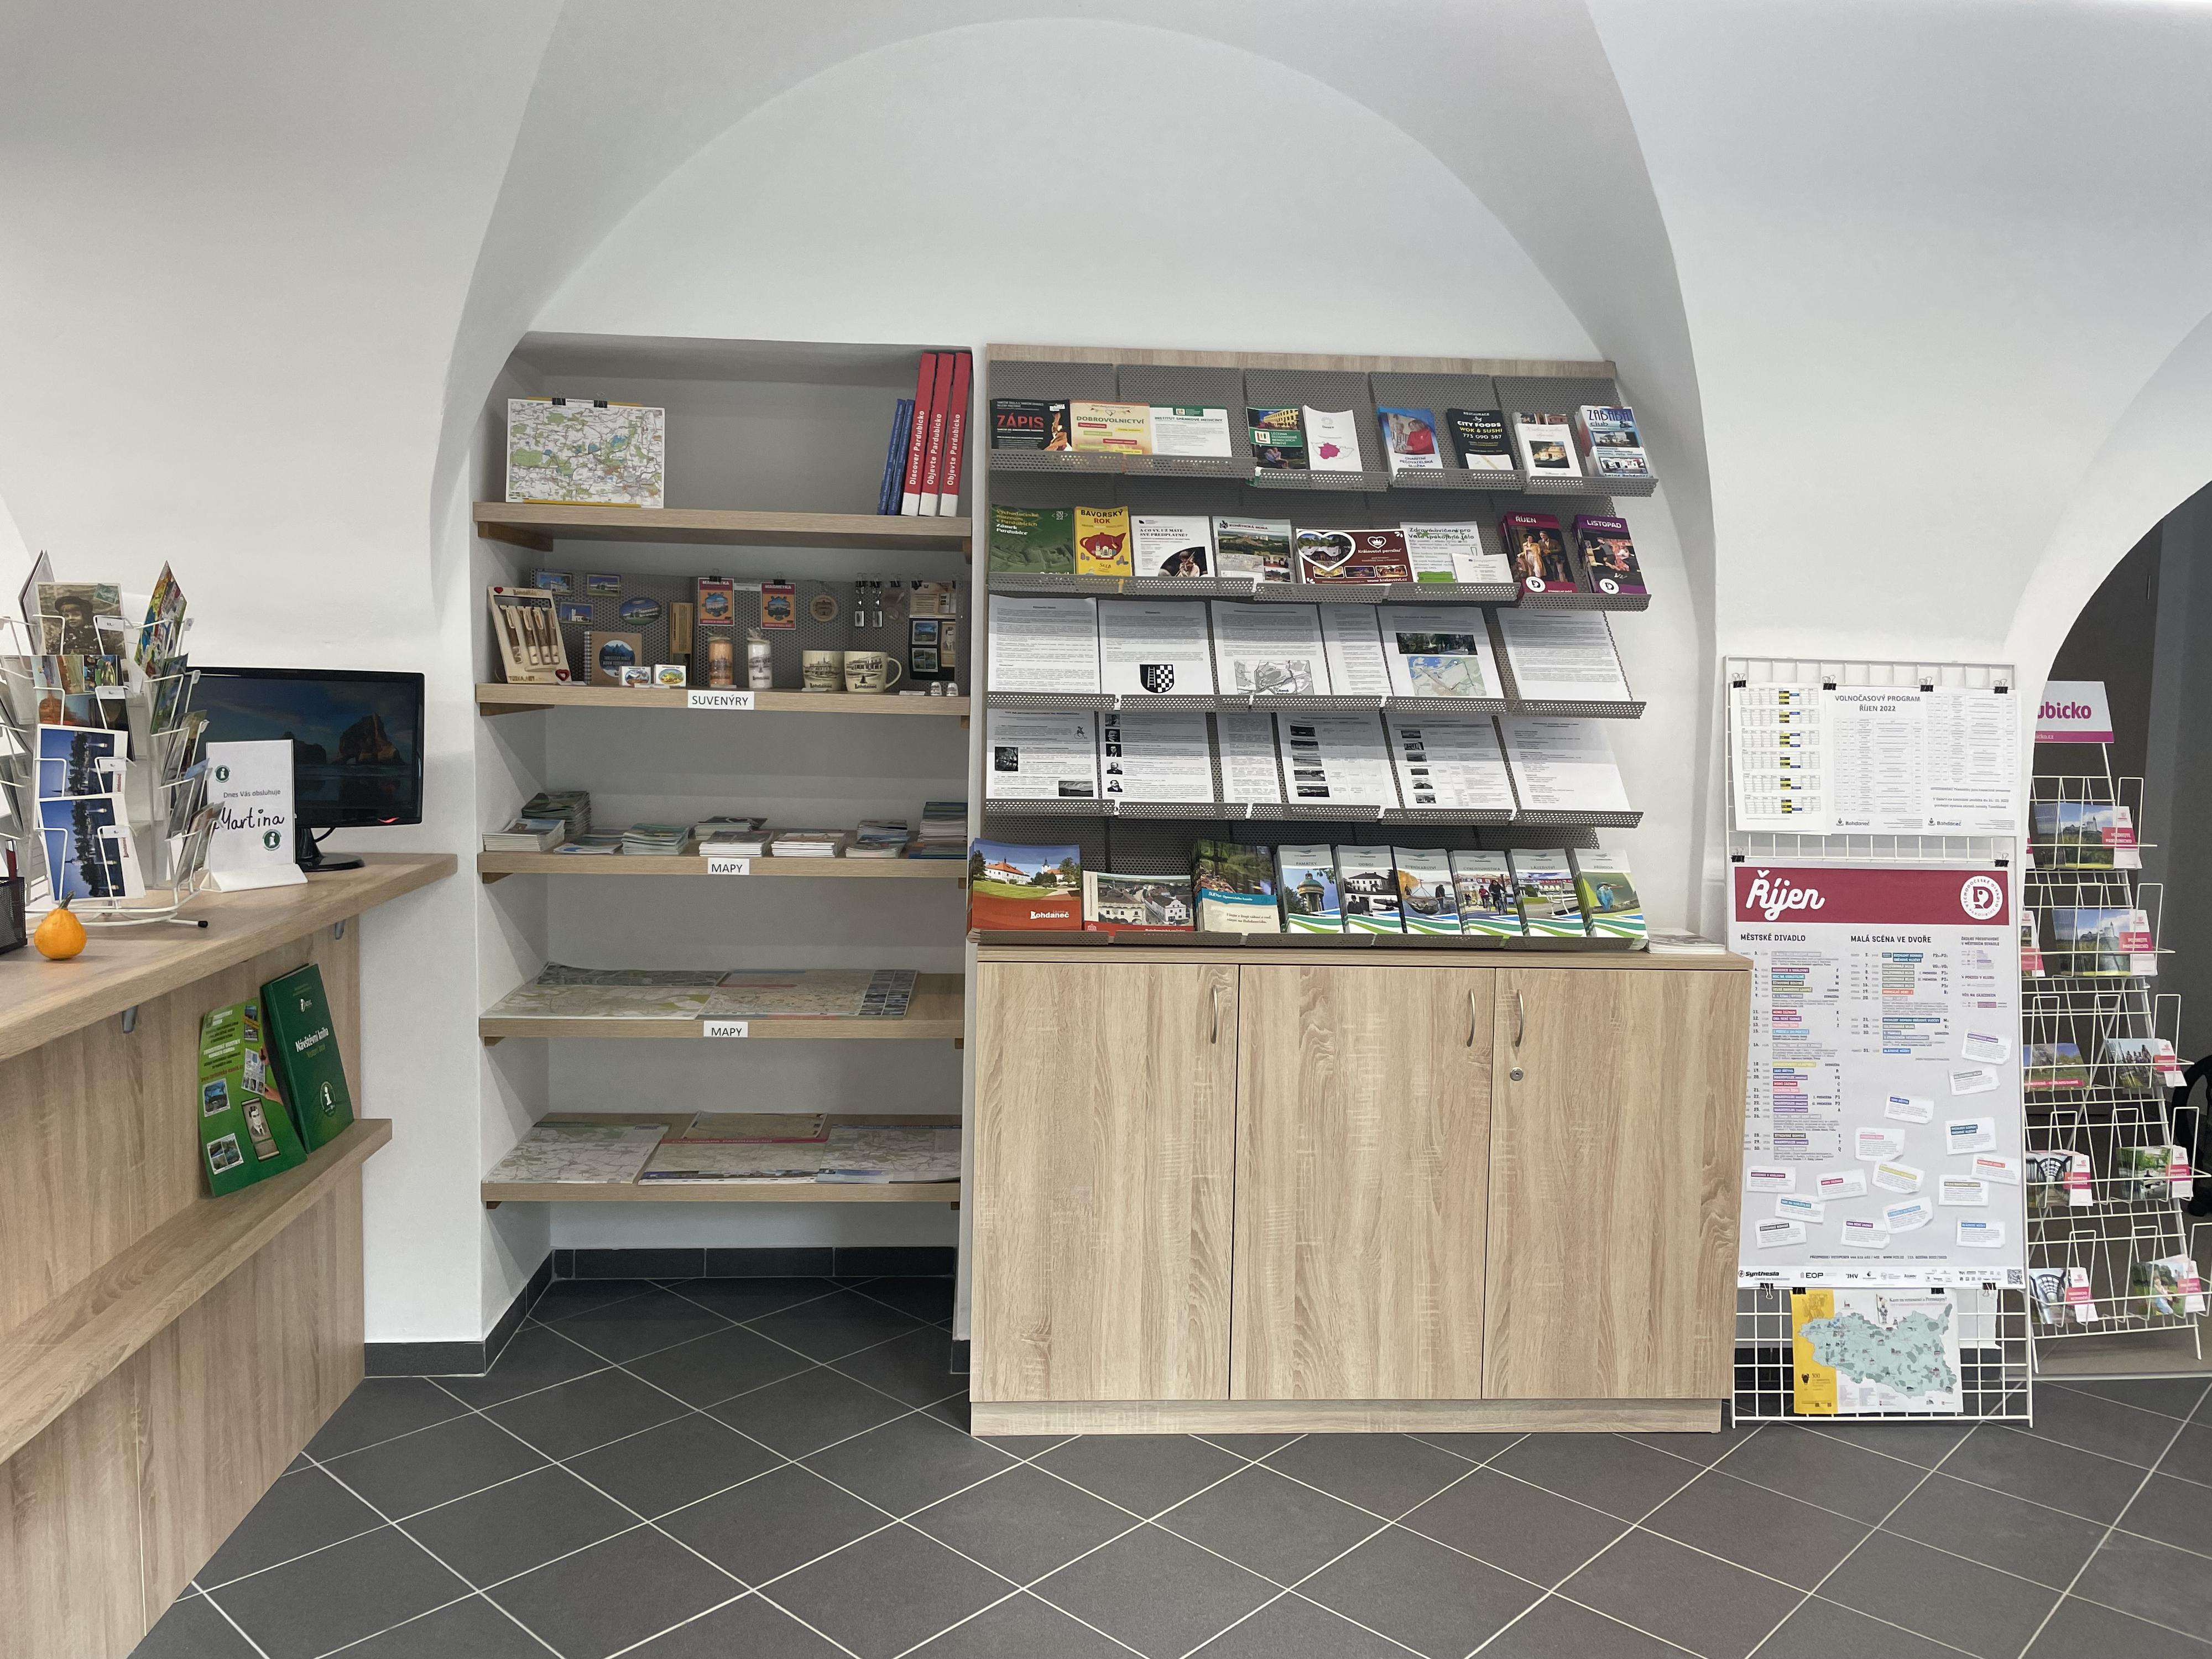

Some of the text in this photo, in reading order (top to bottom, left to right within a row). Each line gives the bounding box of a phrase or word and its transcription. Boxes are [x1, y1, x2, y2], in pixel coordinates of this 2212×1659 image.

[997, 412, 1044, 429] ZÁPIS
[1077, 416, 1144, 424] DOBROVOLNICTVÍ
[1587, 409, 1632, 421] ZABABA
[909, 410, 925, 485] Discover Pardubicko
[927, 414, 942, 485] Objevte Pardubicko
[947, 414, 961, 486] Objevte Pardubicko
[1081, 508, 1123, 518] BAVORSKÝ
[1515, 515, 1537, 524] ŘÍJEN
[1586, 519, 1622, 529] LISTOPAD
[691, 695, 749, 706] SUVENÝRY
[1835, 693, 1886, 702] VOLNOČASOVÝ
[1859, 703, 1878, 712] ŘÍJEN
[214, 807, 284, 830] Martina
[711, 863, 743, 874] MAPY
[1745, 869, 1825, 921] Říjen
[1030, 911, 1070, 920] Bohdaneč
[1740, 932, 1772, 942] MĚSTSKÉ
[1850, 934, 1870, 942] MALÁ
[1871, 934, 1895, 942] SCÉNA
[1908, 935, 1932, 943] DVOŘE
[711, 1026, 743, 1037] MAPY
[295, 1027, 329, 1053] Návštěvní kniha
